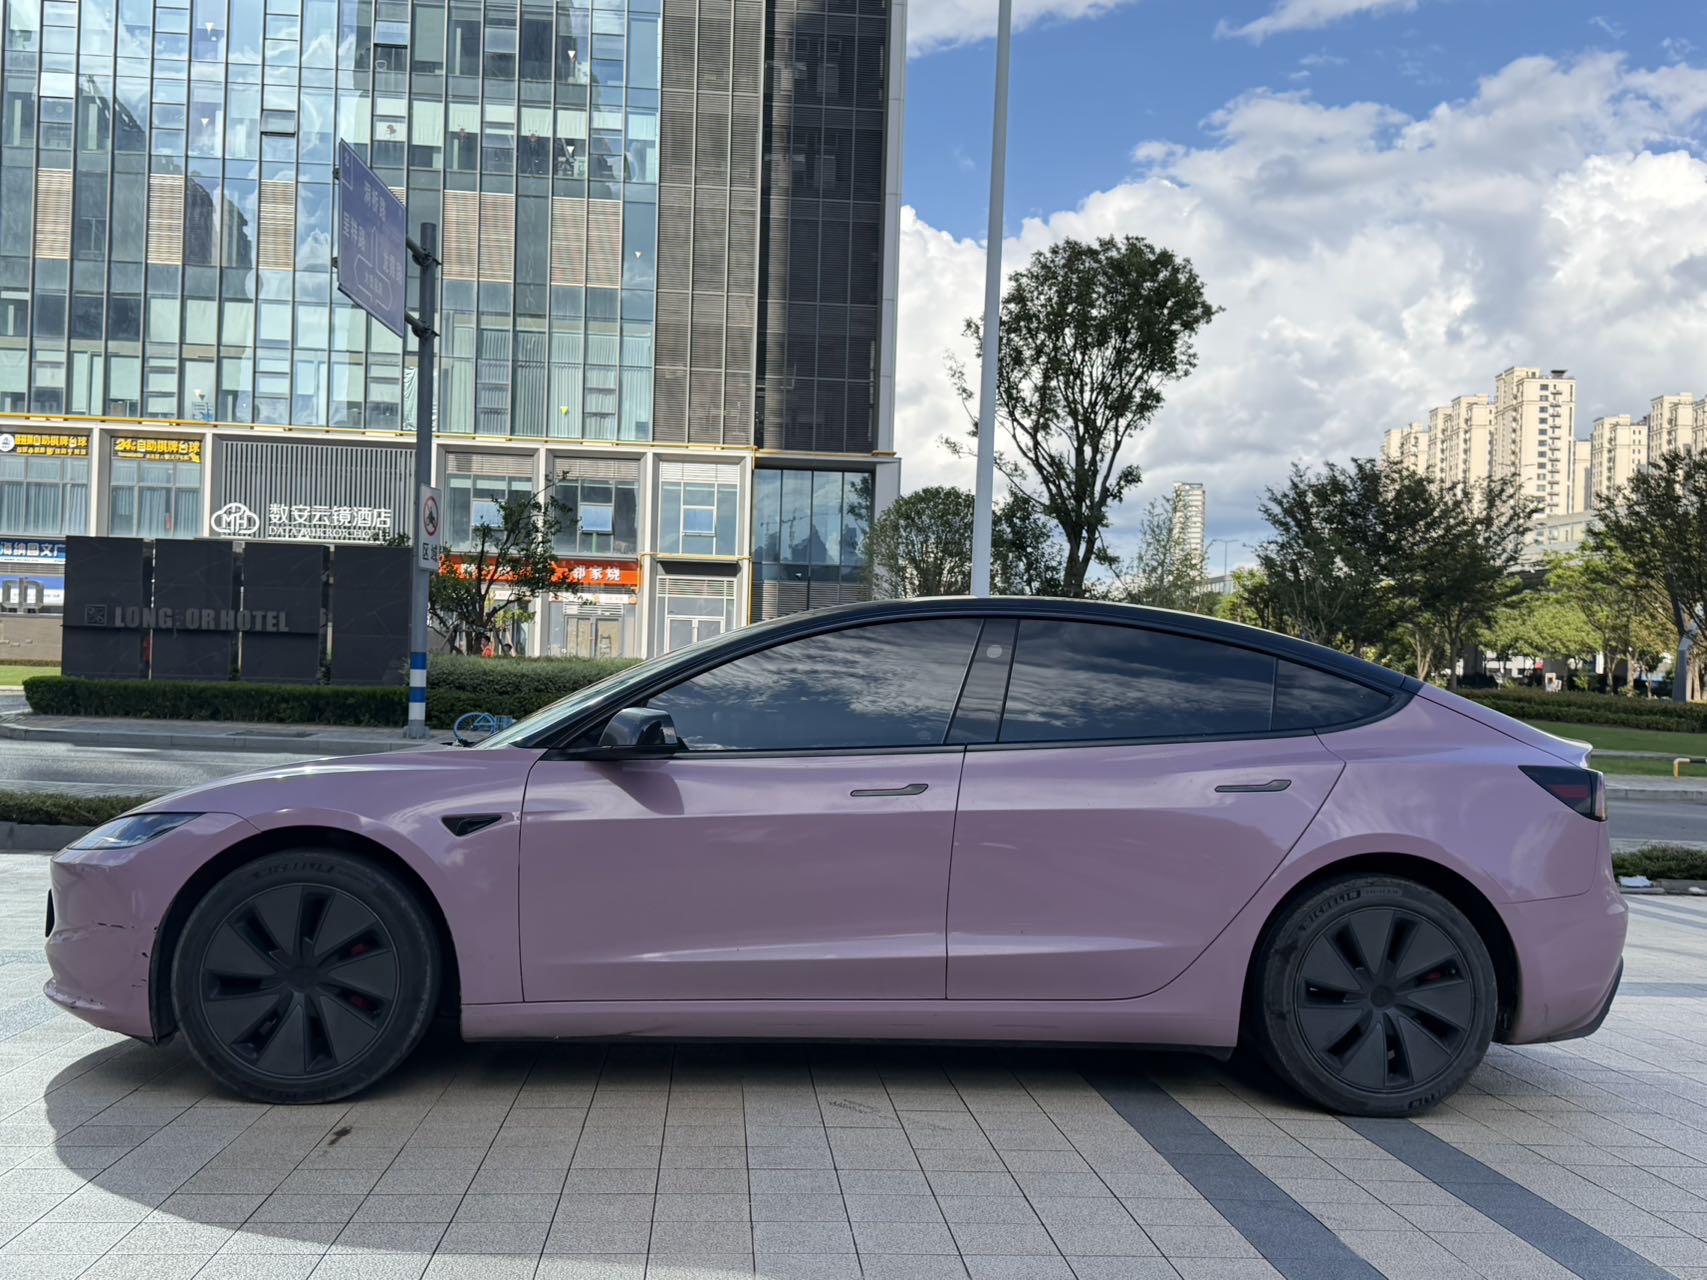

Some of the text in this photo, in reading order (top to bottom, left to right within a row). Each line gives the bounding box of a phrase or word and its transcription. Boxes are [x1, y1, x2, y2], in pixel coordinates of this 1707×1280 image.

[269, 504, 392, 528] 数安云镜酒店
[220, 608, 289, 632] HOTEL
